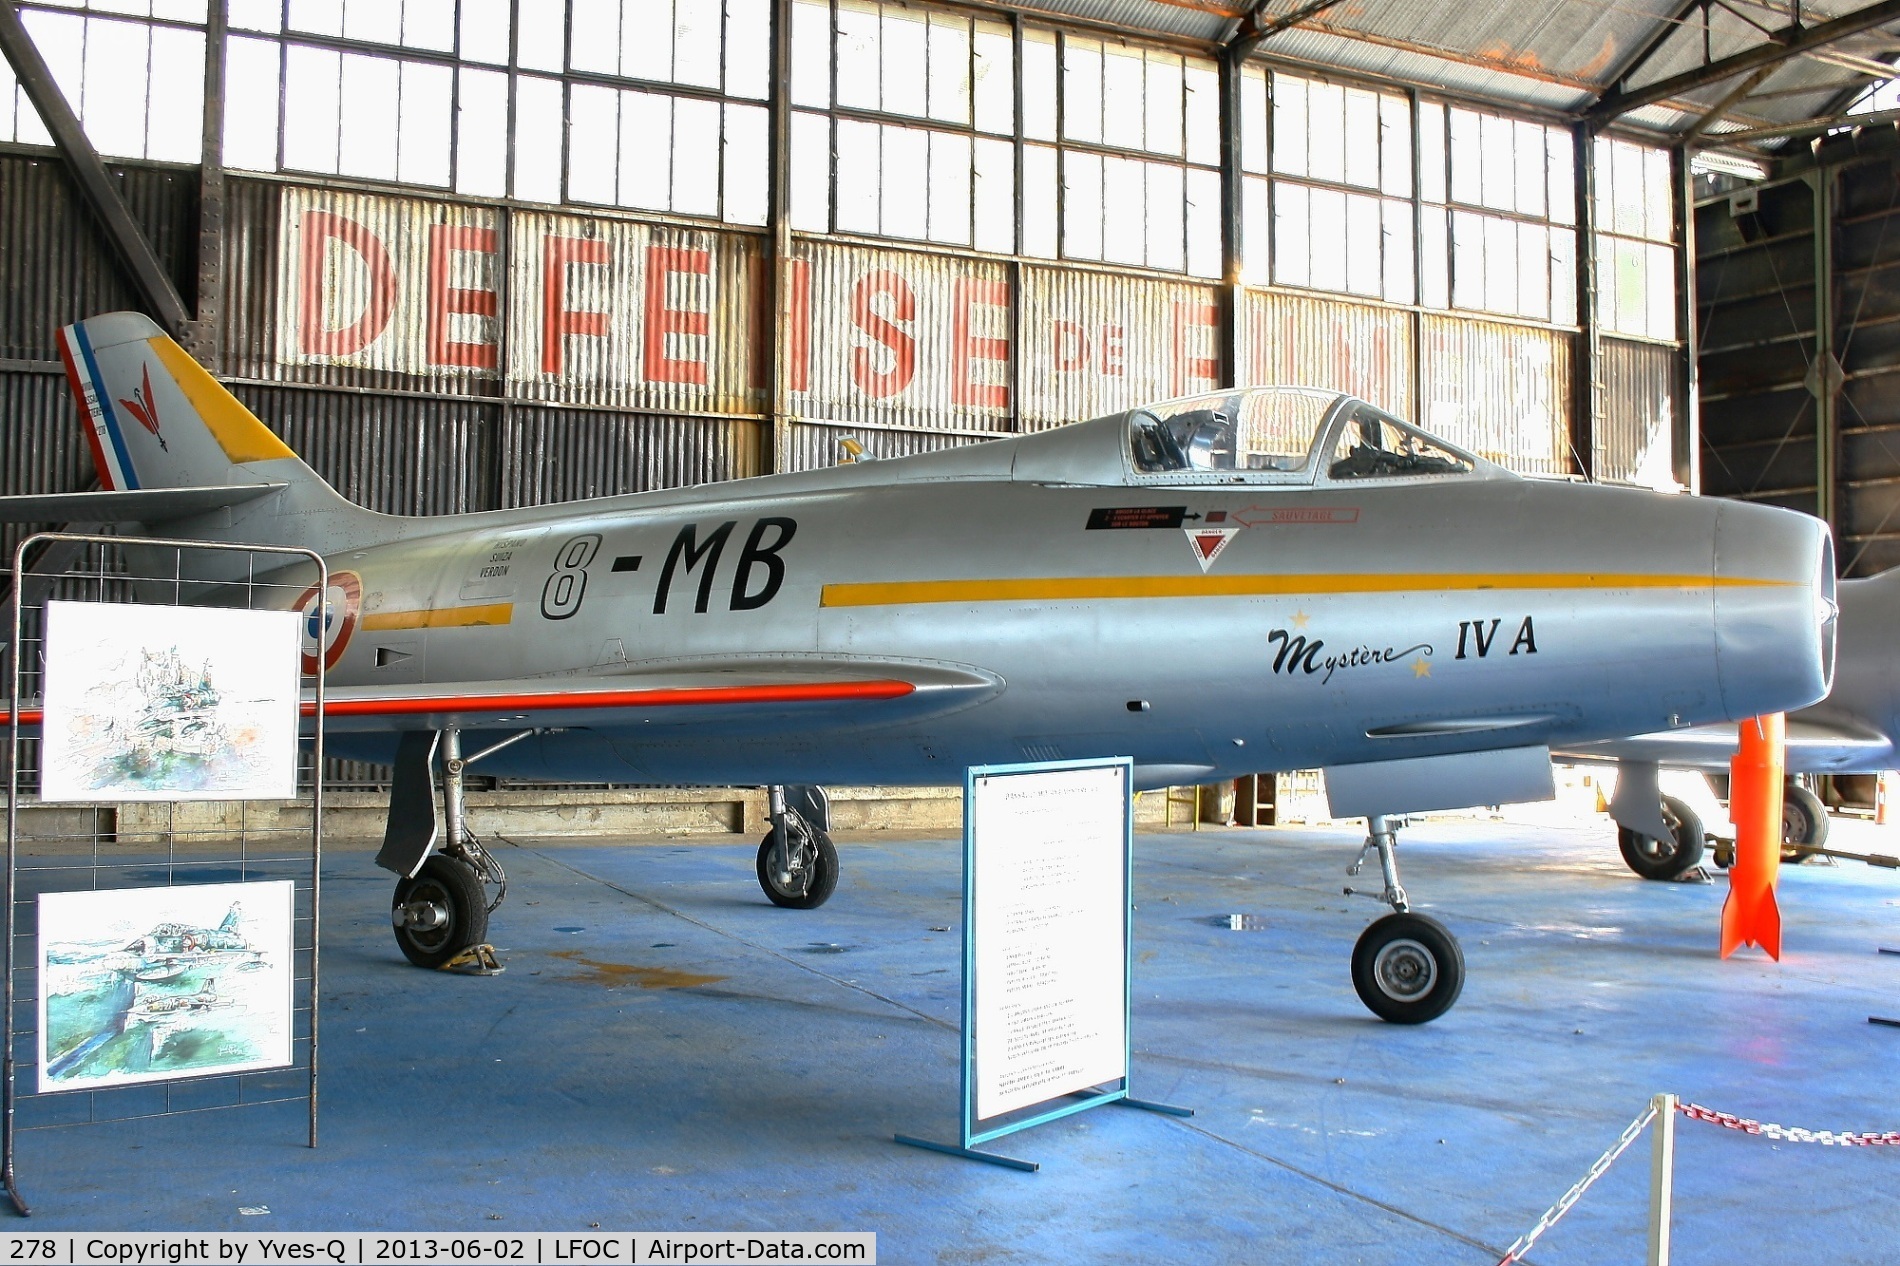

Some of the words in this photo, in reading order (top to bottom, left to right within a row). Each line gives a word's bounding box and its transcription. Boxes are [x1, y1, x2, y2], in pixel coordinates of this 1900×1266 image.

[1053, 319, 1124, 376] DE
[1272, 510, 1334, 521] SAUVETAGE
[489, 551, 513, 562] SUIZA
[479, 565, 510, 578] VERDON
[1267, 628, 1434, 685] Mystère
[1455, 618, 1502, 660] IV
[1508, 615, 1538, 656] A
